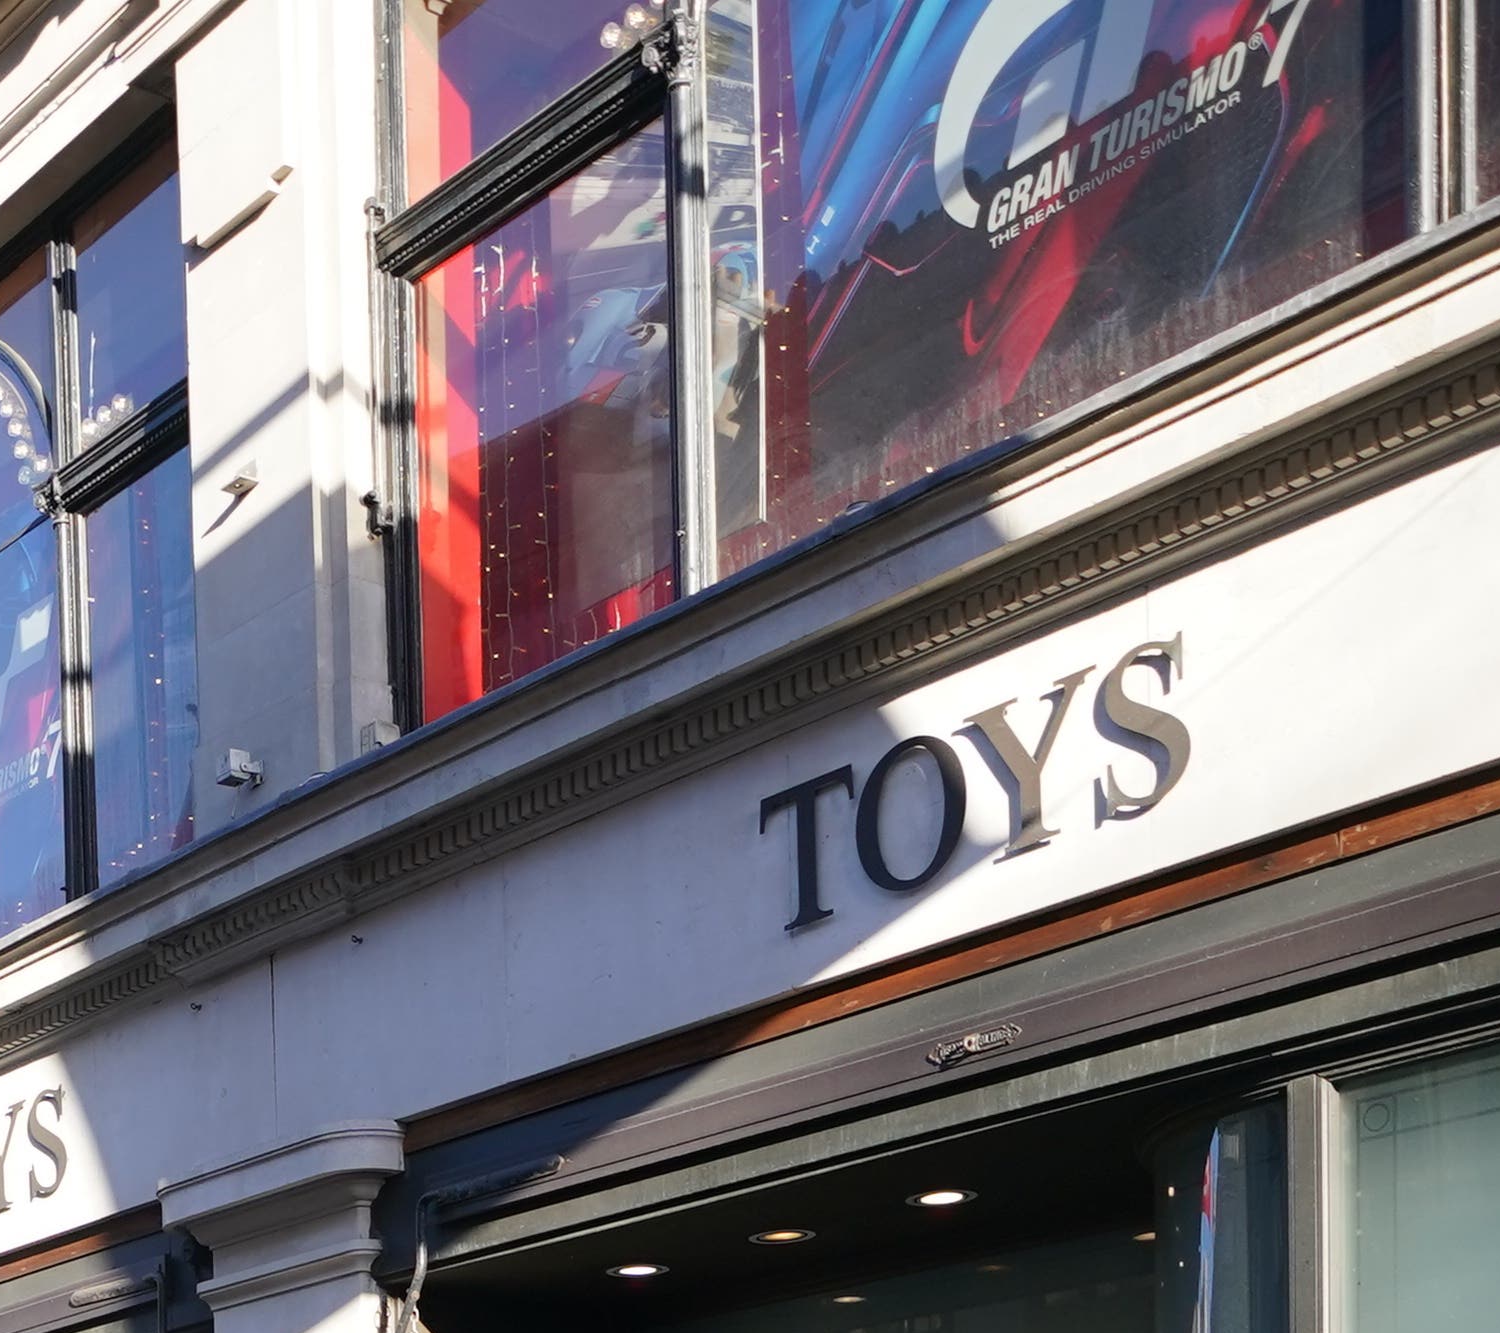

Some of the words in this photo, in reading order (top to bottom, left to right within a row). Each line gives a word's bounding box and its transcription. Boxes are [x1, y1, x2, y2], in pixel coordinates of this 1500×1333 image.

[987, 143, 1080, 233] GRAN
[988, 223, 1020, 250] THE
[1023, 199, 1066, 232] REAL
[1069, 156, 1137, 203] DRIVING
[1139, 91, 1242, 161] SIMULATOR
[759, 633, 1191, 935] TOYS
